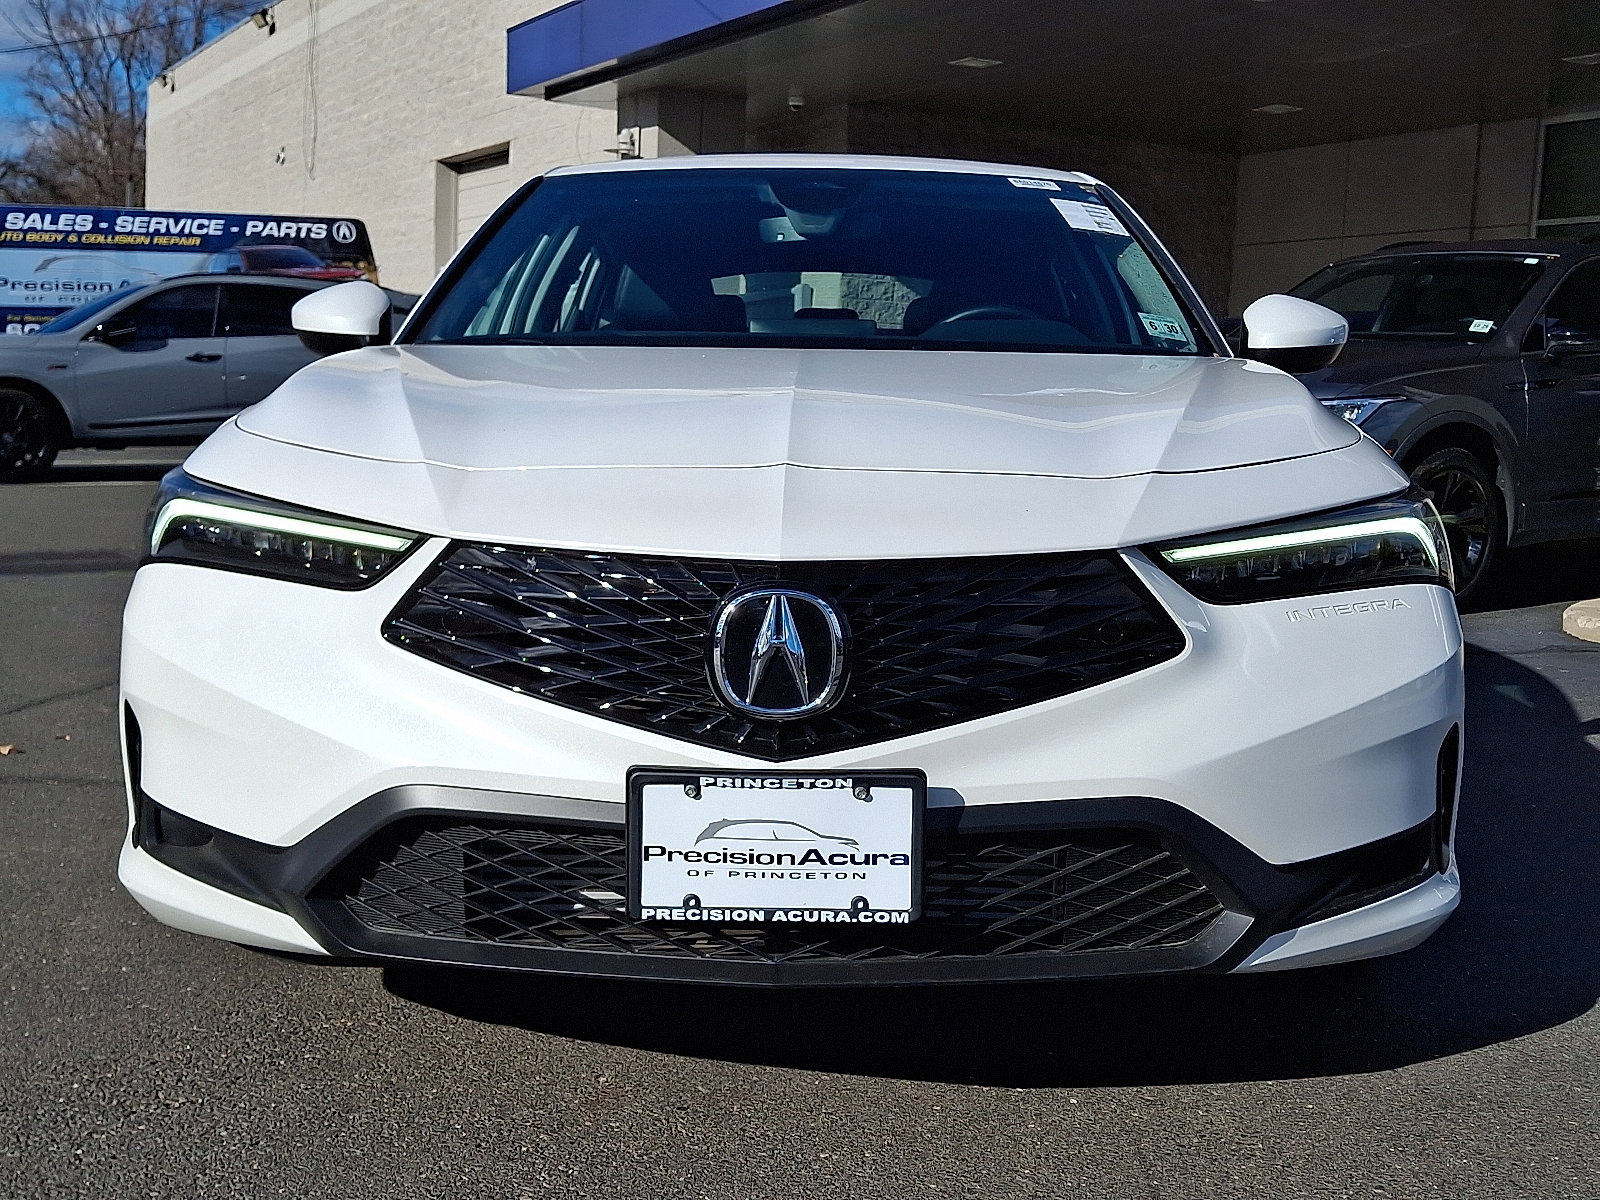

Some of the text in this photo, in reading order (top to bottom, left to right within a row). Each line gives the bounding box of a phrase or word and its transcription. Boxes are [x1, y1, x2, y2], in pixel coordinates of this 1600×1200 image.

[5, 212, 94, 231] SALES
[114, 215, 226, 236] SERVICE
[245, 220, 328, 239] PARTS
[26, 231, 66, 243] BODY
[81, 233, 150, 245] COLLISION
[153, 235, 201, 247] REPAIR
[1164, 323, 1179, 335] 30
[1285, 598, 1411, 622] INTEGRA
[700, 777, 853, 789] PRINCETON
[687, 869, 867, 880] OF PRINCETON
[641, 908, 910, 924] PRECISION ACURA.COM
